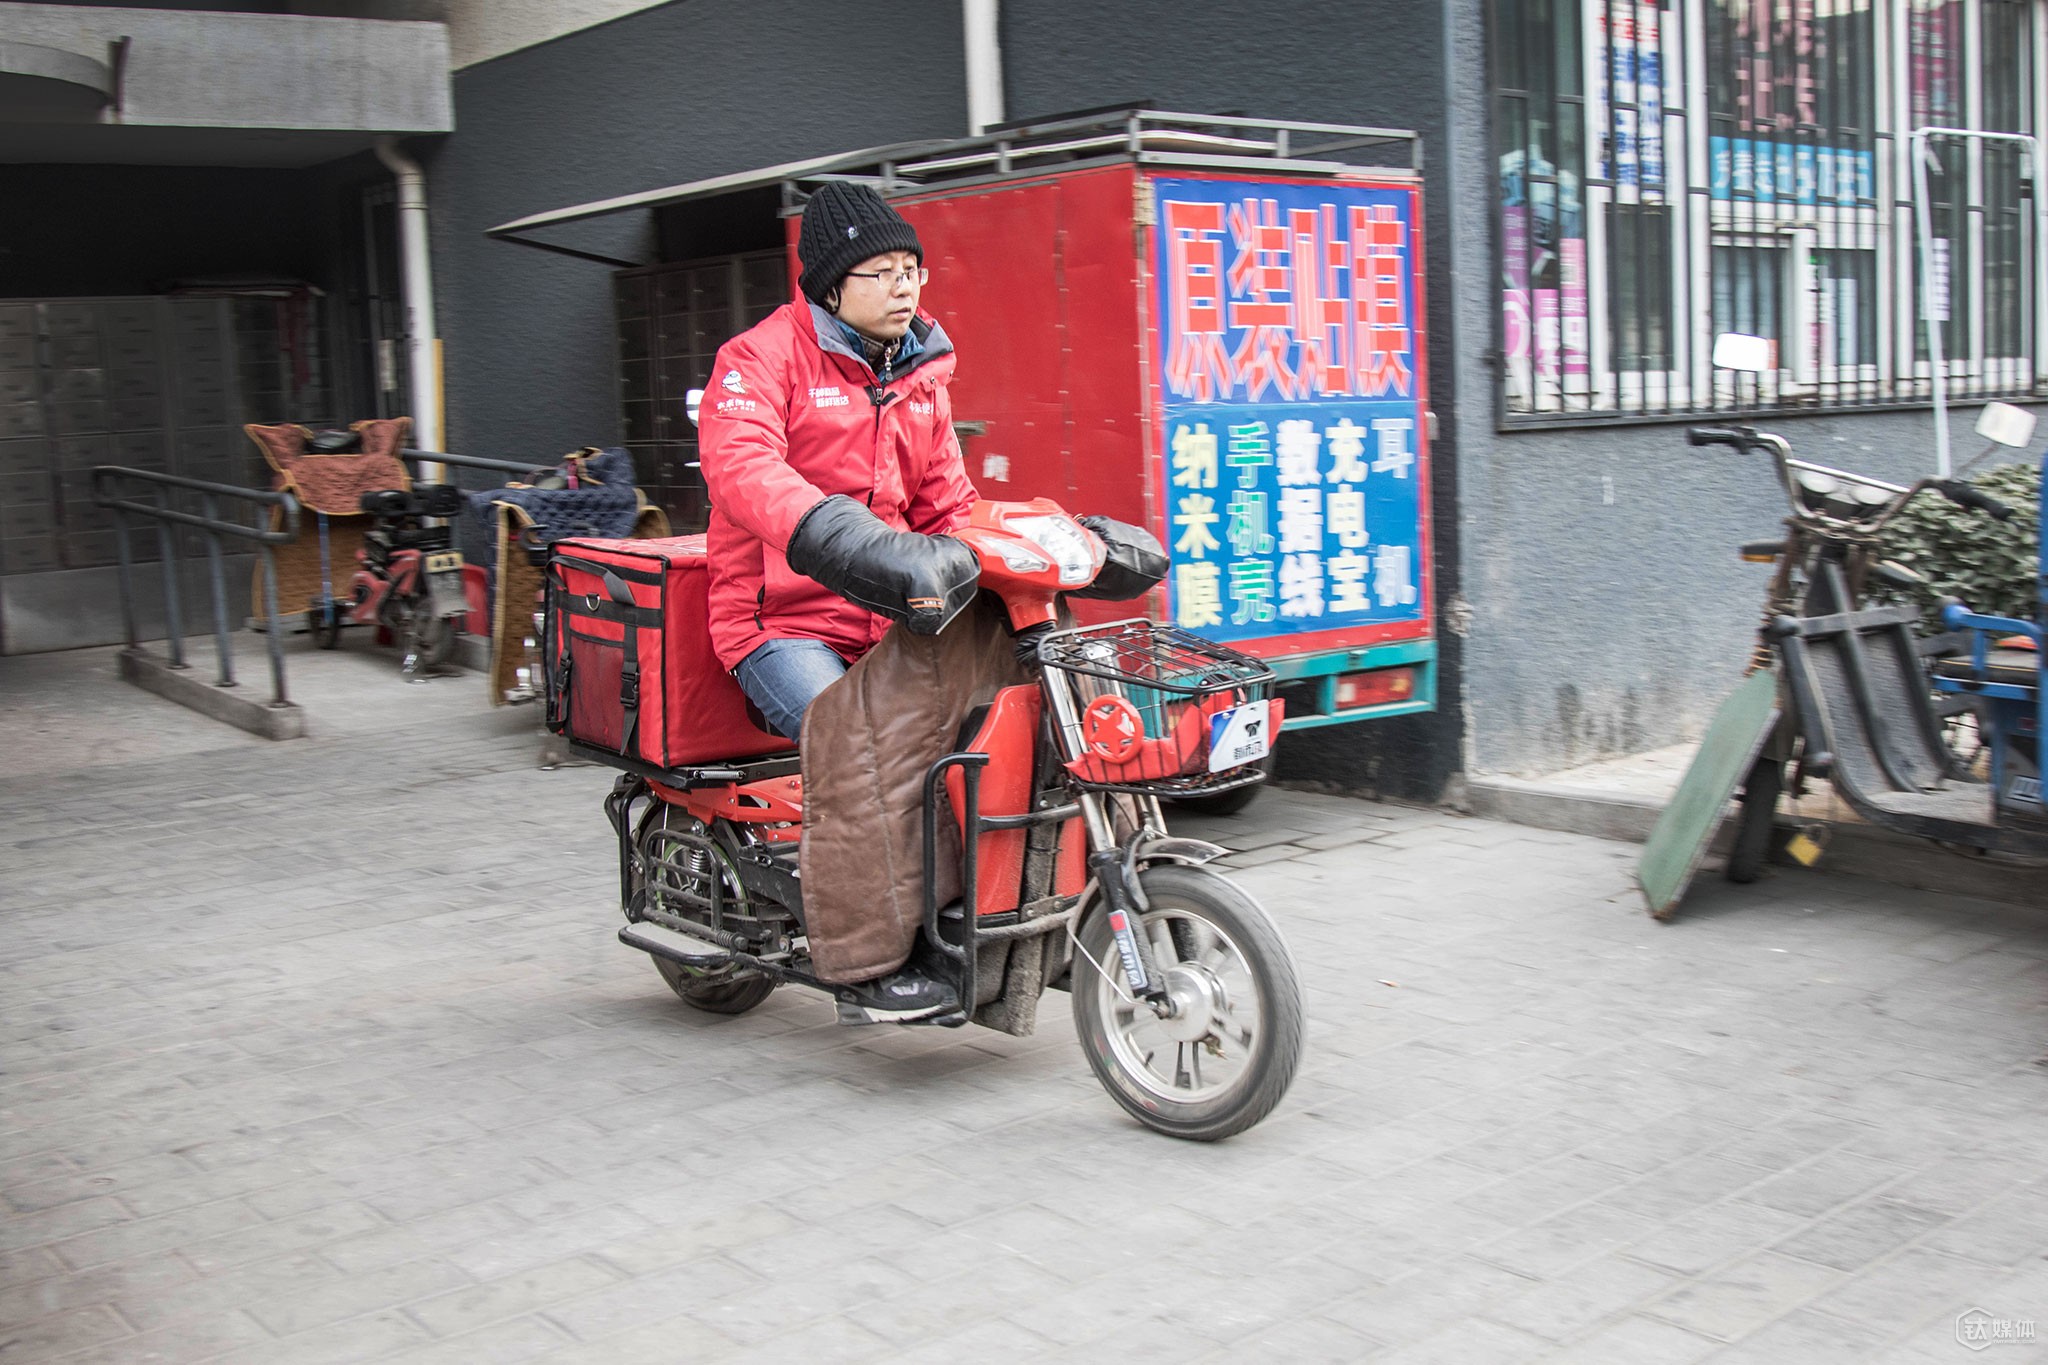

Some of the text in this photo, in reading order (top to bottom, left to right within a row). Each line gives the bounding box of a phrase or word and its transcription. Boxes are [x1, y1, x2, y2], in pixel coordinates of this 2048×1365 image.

[1163, 198, 1412, 403] 原装贴膜
[1171, 422, 1223, 629] 纳米膜
[1226, 421, 1276, 625] 手机壳
[1276, 418, 1324, 618] 数据线
[1325, 417, 1371, 613] 充电宝
[1371, 418, 1417, 607] 耳机
